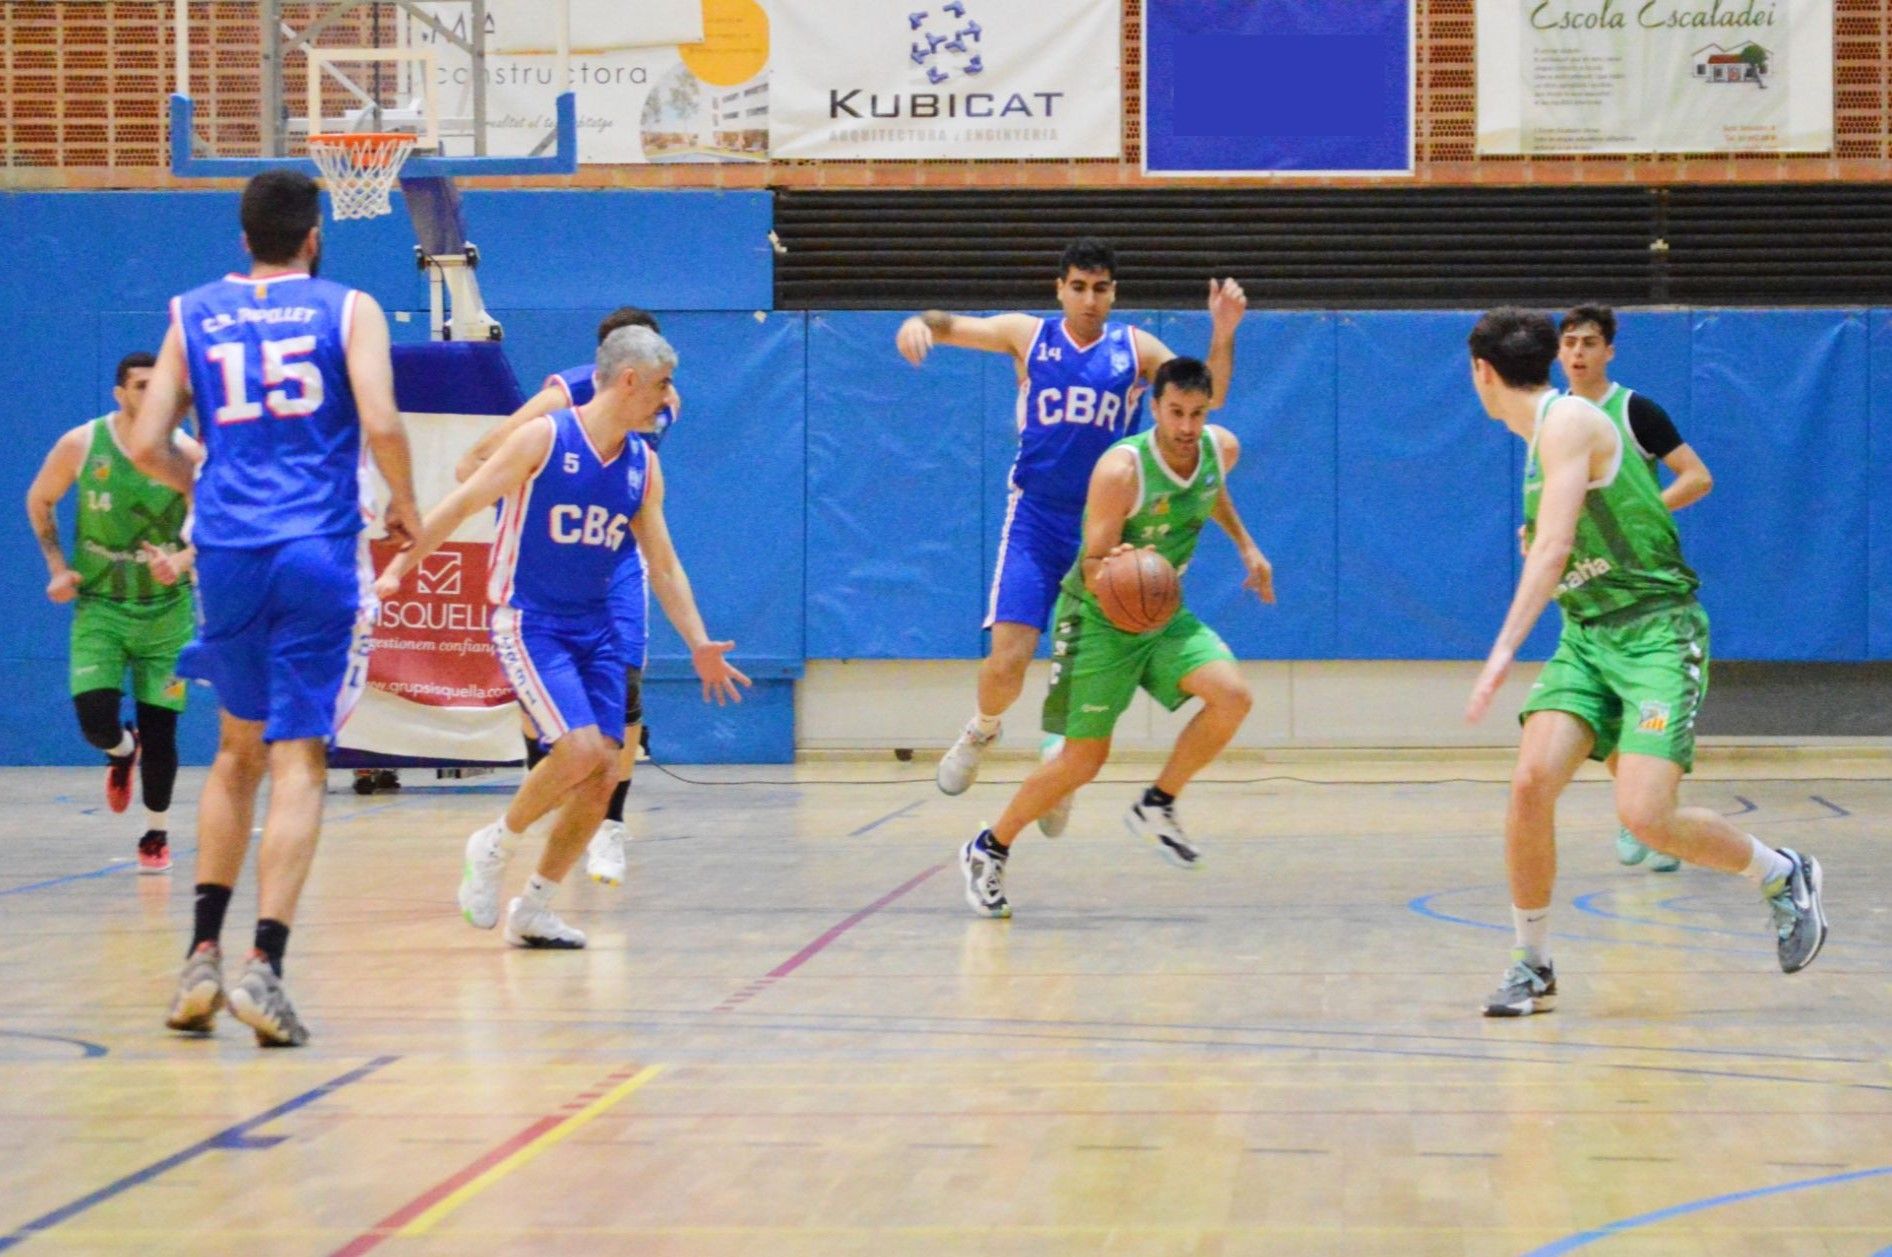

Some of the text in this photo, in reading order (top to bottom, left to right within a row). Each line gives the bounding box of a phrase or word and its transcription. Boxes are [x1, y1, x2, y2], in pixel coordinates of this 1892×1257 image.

[829, 89, 1064, 119] KUBICAT
[1036, 343, 1063, 362] 14
[206, 335, 324, 426] 15
[562, 452, 581, 474] 5
[377, 601, 491, 631] ISQUELL
